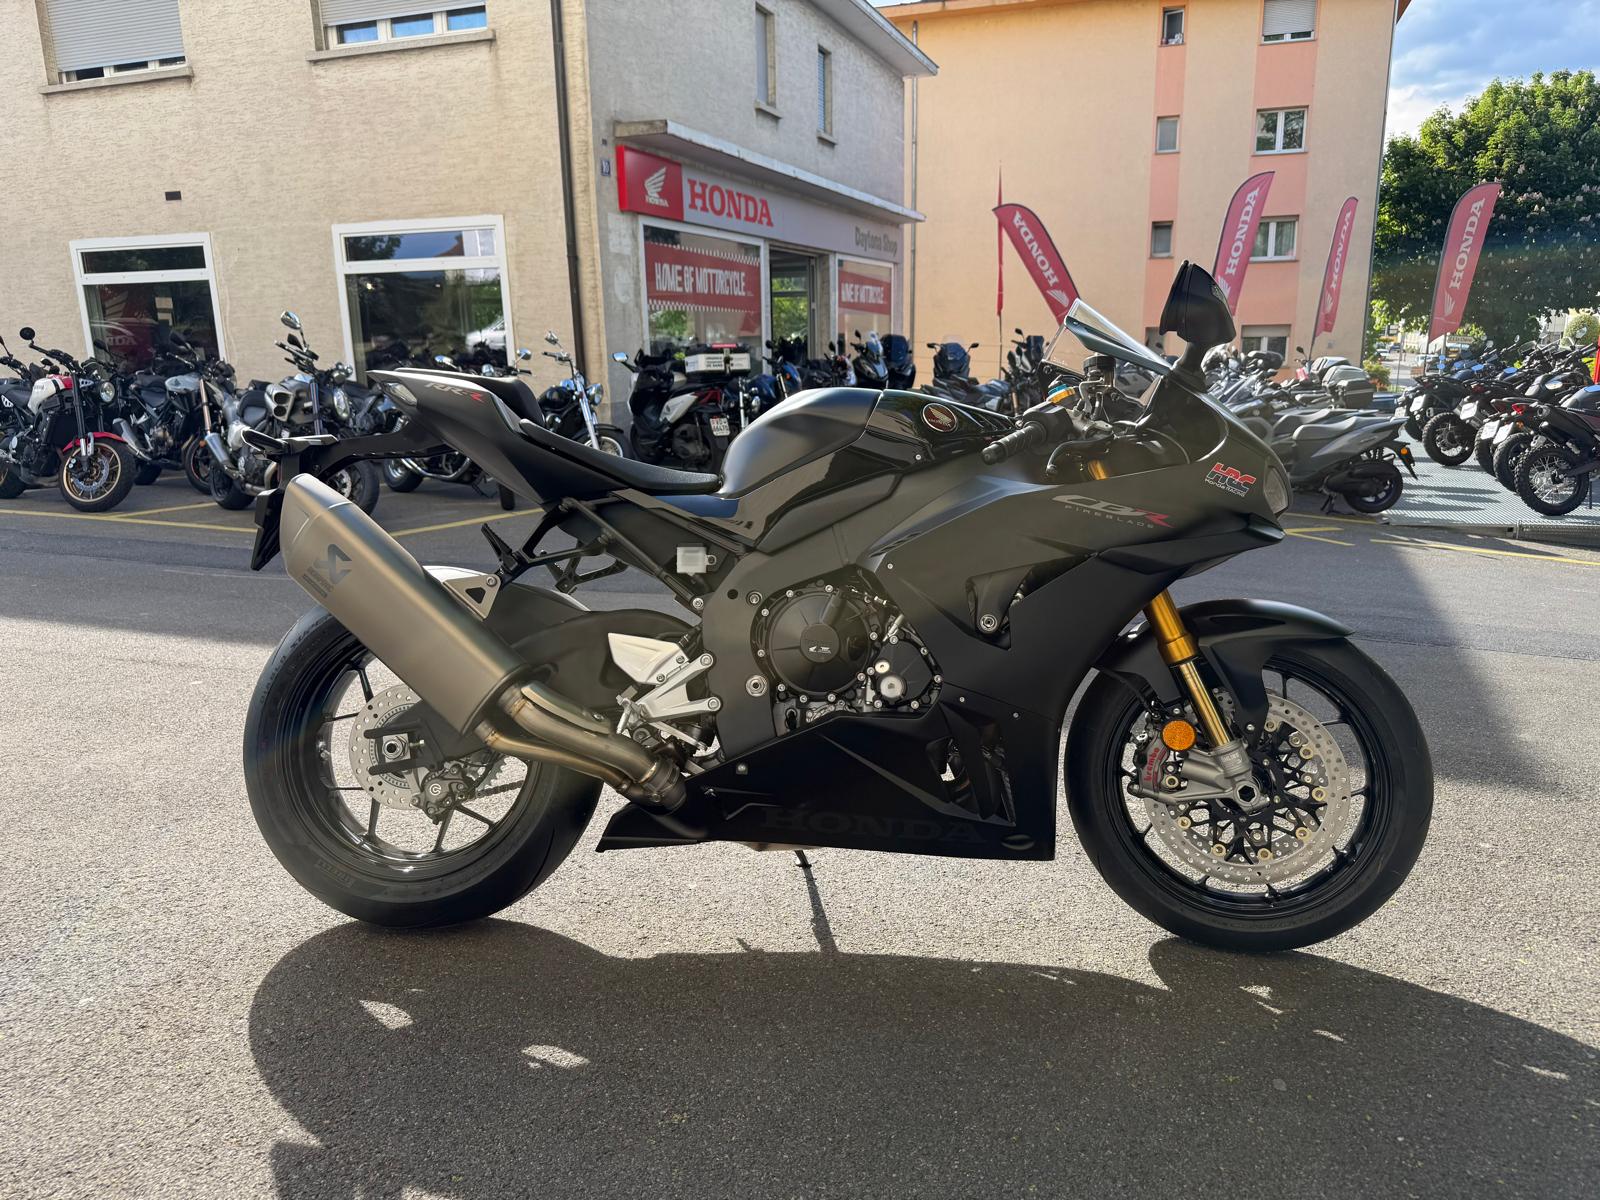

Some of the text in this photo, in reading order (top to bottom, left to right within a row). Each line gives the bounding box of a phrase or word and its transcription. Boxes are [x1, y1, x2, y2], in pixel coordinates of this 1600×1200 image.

[687, 178, 774, 228] HONDA
[882, 233, 898, 258] Shop
[1013, 210, 1059, 288] HONDA
[1225, 187, 1260, 275] HONDA
[1331, 207, 1352, 290] HONDA
[1449, 198, 1486, 290] HONDA
[655, 262, 683, 292] HOME
[683, 265, 694, 293] OF
[1064, 504, 1155, 529] FIREBLADE
[1143, 747, 1160, 782] brembo
[759, 806, 987, 843] HONDA
